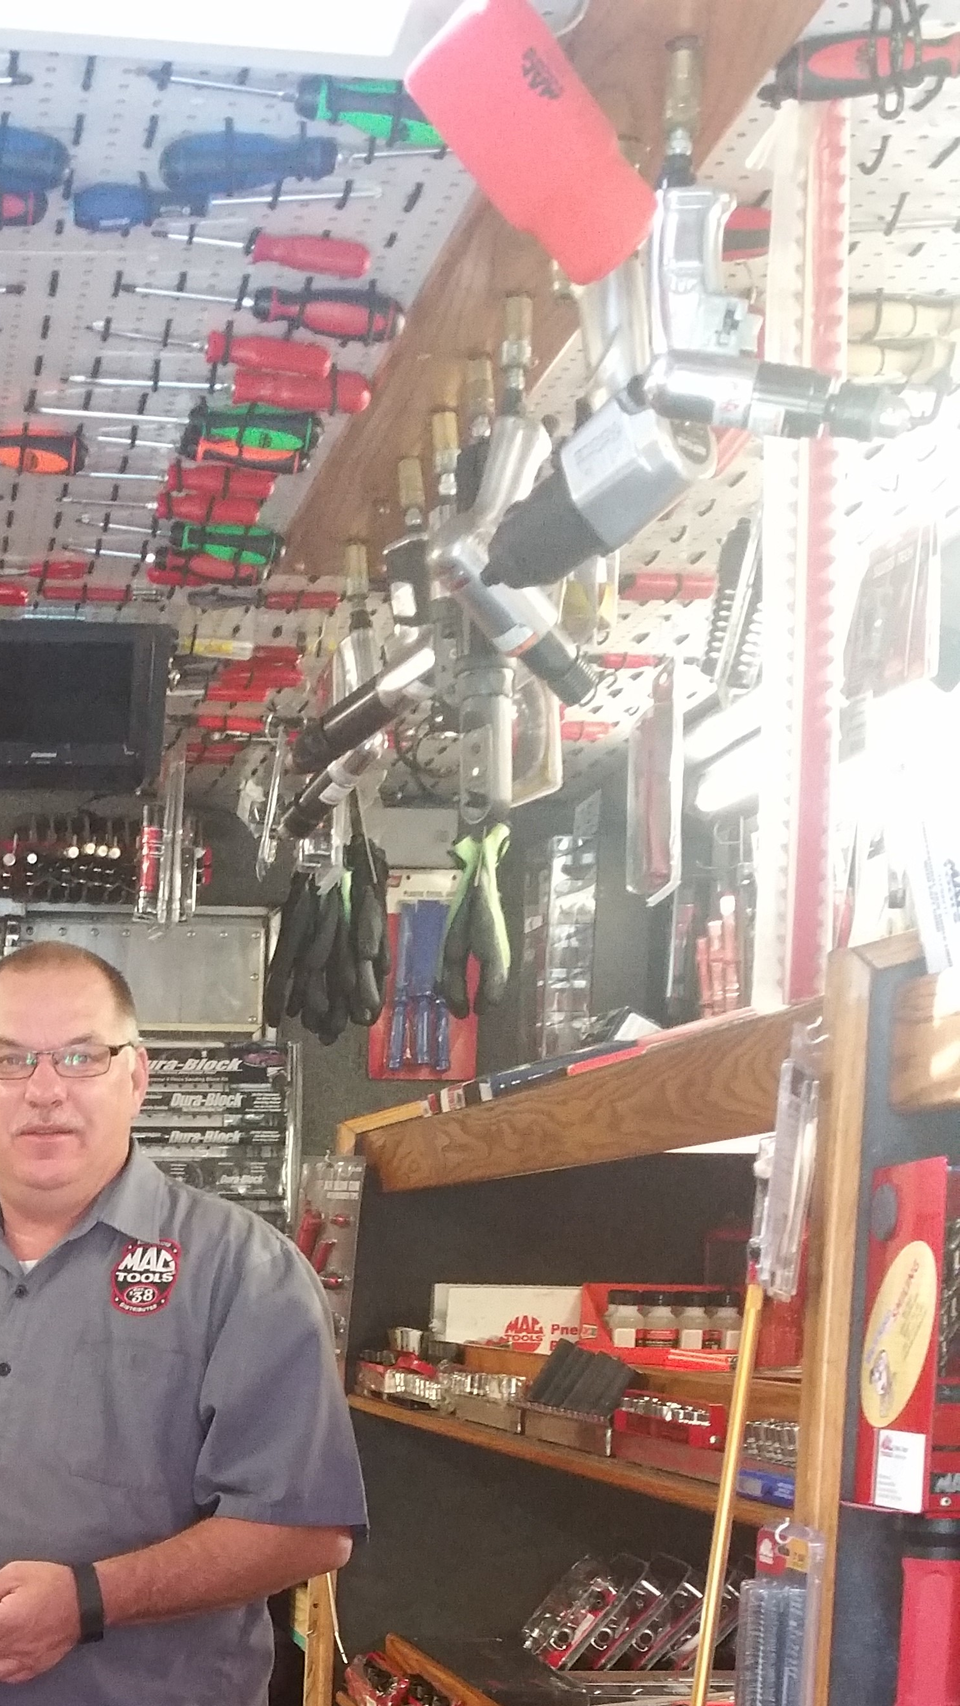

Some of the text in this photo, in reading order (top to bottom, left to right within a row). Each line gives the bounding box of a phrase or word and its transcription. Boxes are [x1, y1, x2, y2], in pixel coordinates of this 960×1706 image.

[146, 1057, 243, 1072] ura-Block
[170, 1092, 244, 1107] Dura-Block
[168, 1130, 241, 1144] Dura-Block
[220, 1174, 265, 1184] Dura-Block
[118, 1247, 176, 1273] MAC
[115, 1272, 175, 1283] TOOLS
[504, 1315, 545, 1335] MAC
[551, 1323, 578, 1336] Pne
[503, 1334, 544, 1342] TOOLS
